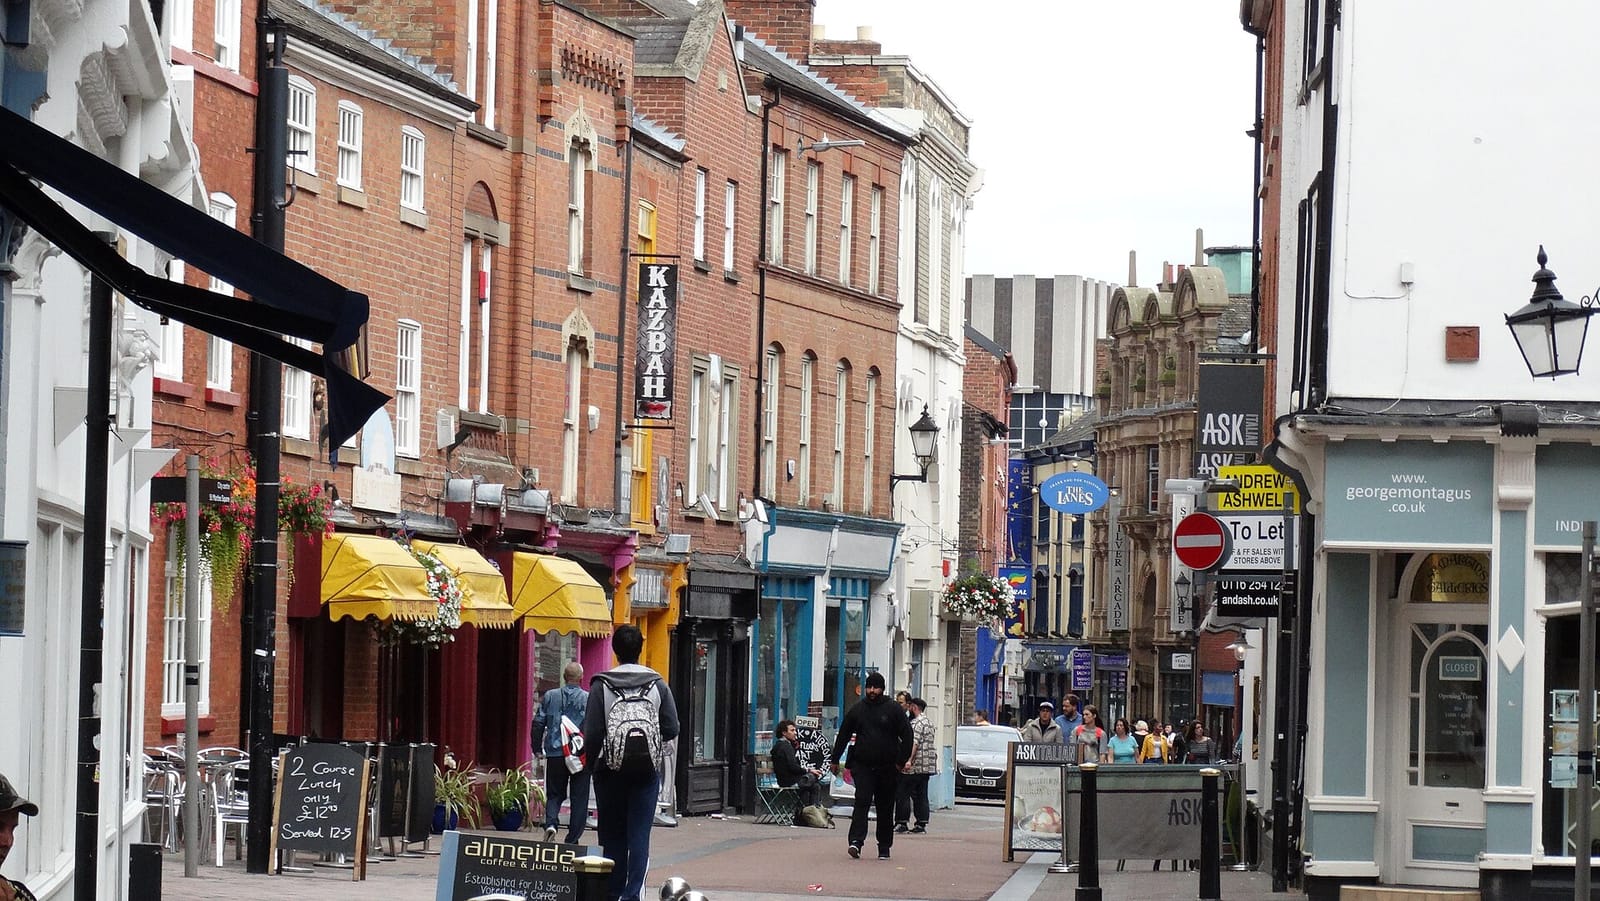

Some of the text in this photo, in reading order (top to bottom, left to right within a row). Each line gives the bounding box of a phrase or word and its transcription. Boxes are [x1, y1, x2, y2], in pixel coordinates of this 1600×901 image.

[642, 266, 670, 398] KAZBAH
[1202, 413, 1244, 446] ASK
[1225, 474, 1285, 489] NDREW
[1391, 474, 1427, 484] www.
[1066, 486, 1083, 495] THE
[1346, 487, 1472, 502] georgemontagus
[1057, 491, 1094, 506] LANES
[1223, 492, 1283, 508] ASHWEL
[1388, 501, 1426, 513] .co.uk
[1230, 521, 1284, 540] To Let
[1252, 548, 1271, 556] SALES
[1273, 548, 1284, 556] WIT
[1114, 524, 1123, 628] ILVER ARCADE
[1222, 595, 1279, 606] andash.co.uk
[1445, 662, 1475, 673] CLOSED
[797, 719, 817, 727] OPEN
[1016, 744, 1036, 760] ASK
[291, 756, 355, 776] 2 Course
[298, 778, 341, 793] Lunch
[303, 795, 330, 805] only
[1168, 798, 1202, 826] ASK
[281, 823, 352, 840] Served 12-5
[465, 838, 576, 865] almeida
[480, 858, 576, 873] coffee & juice ba
[464, 871, 516, 888] Established
[534, 880, 543, 891] 13
[480, 885, 506, 896] Voted
